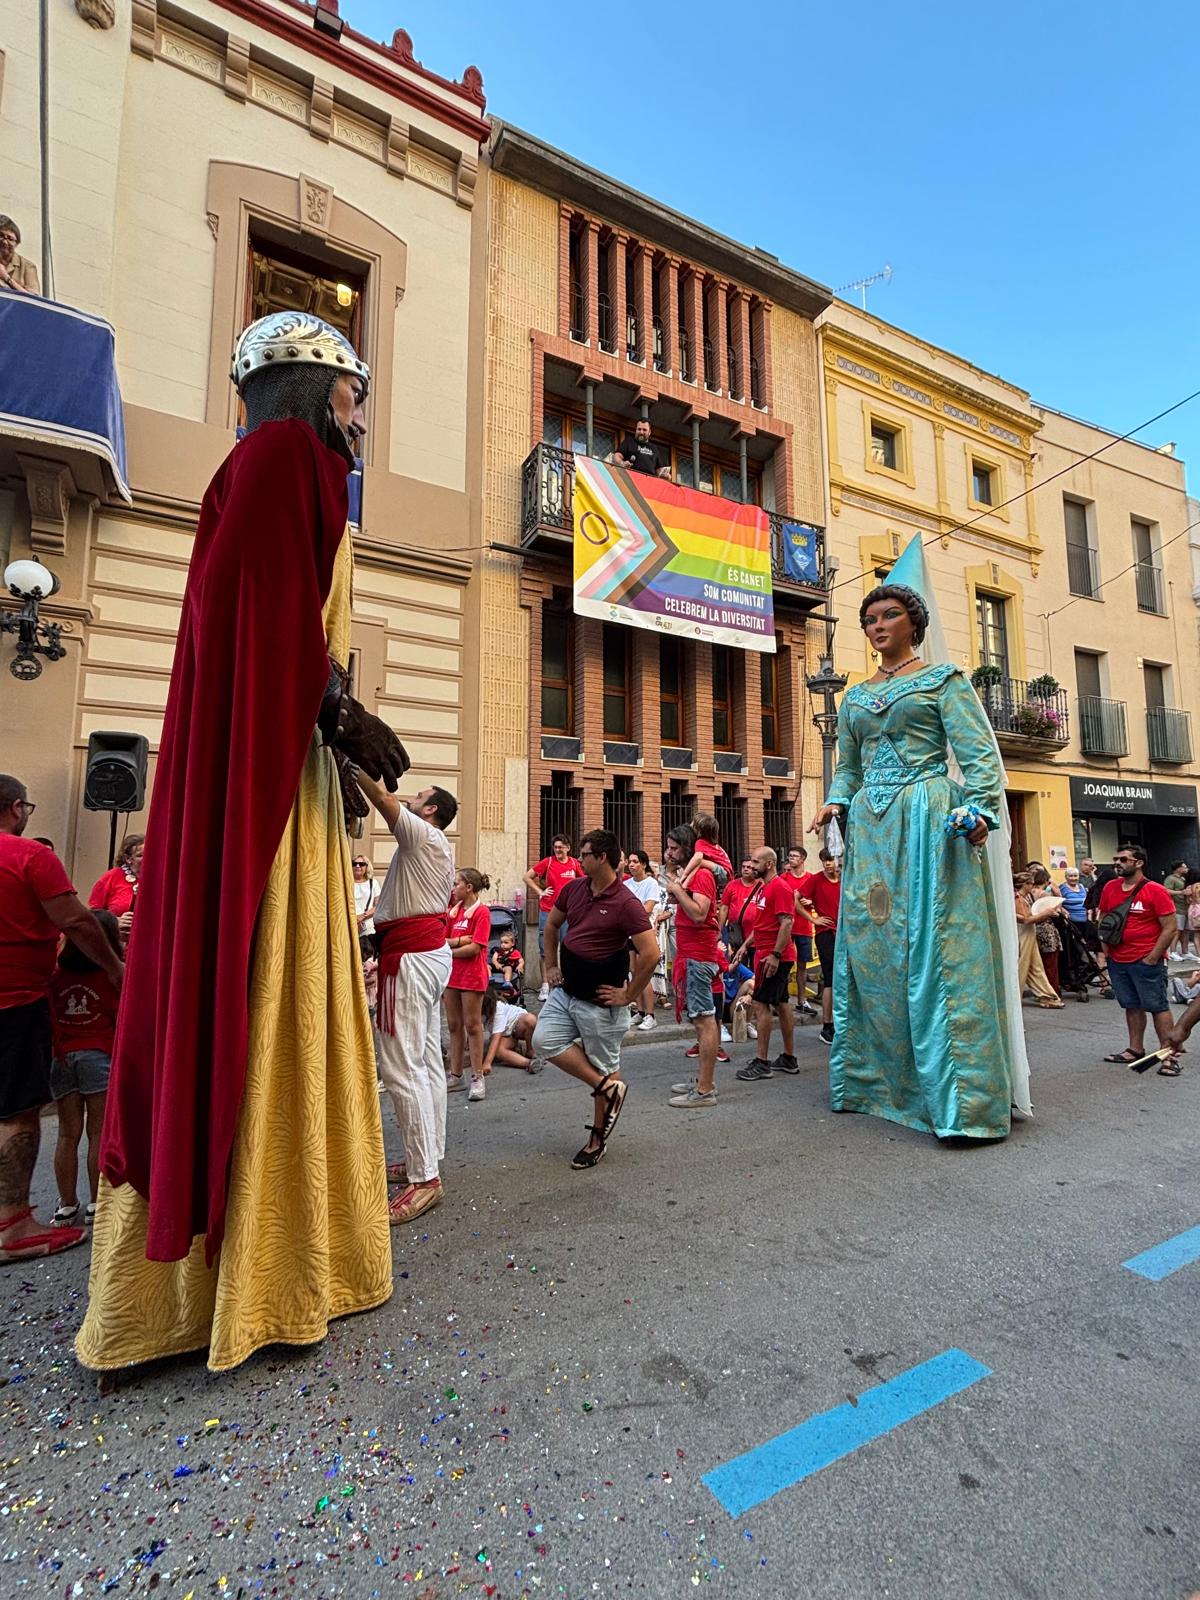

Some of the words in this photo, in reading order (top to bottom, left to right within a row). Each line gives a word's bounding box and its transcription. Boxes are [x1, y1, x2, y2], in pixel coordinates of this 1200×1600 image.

[728, 567, 739, 581] ÉS
[740, 571, 765, 588] CANET
[704, 583, 719, 600] SOM
[721, 589, 765, 609] COMUNITAT
[665, 597, 707, 619] CELEBREM
[709, 607, 720, 623] LA
[722, 610, 765, 631] DIVERSITAT
[1083, 783, 1124, 797] JOAQUIM
[1125, 786, 1153, 799] BRAUN
[1105, 800, 1134, 810] Advocat
